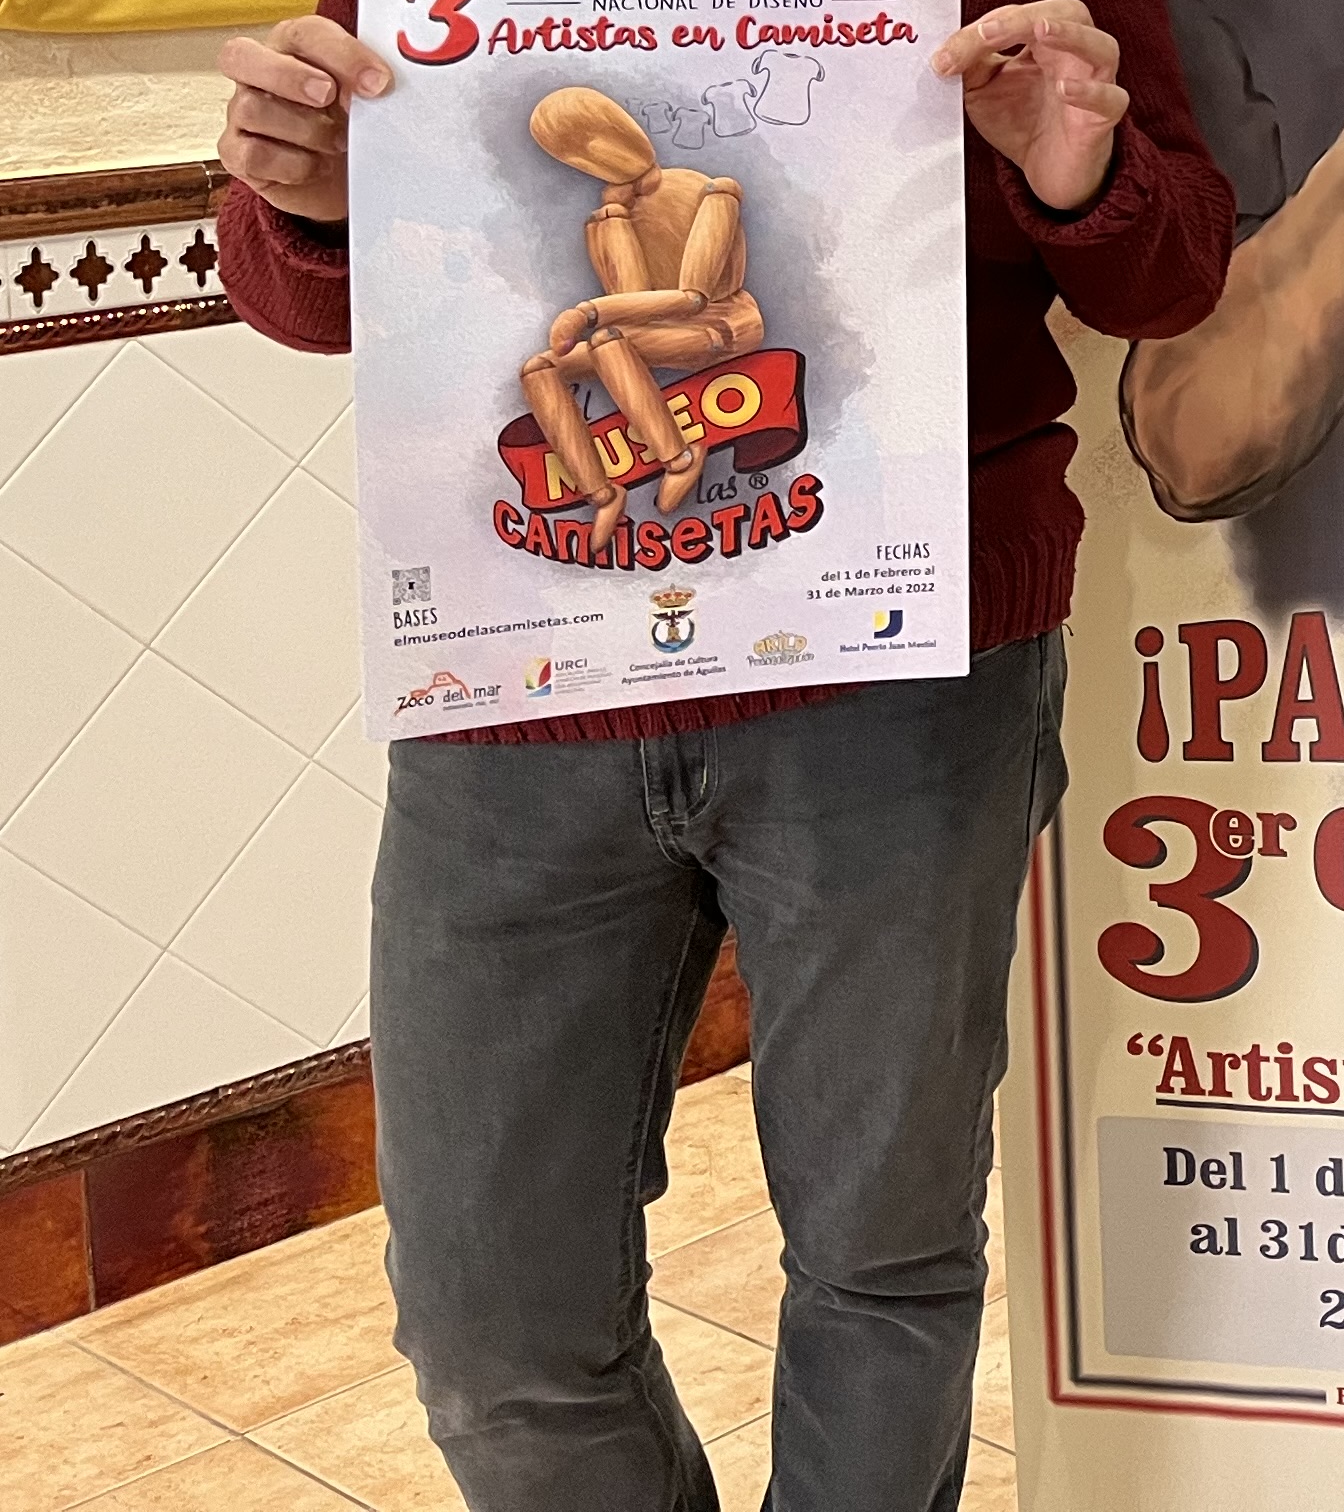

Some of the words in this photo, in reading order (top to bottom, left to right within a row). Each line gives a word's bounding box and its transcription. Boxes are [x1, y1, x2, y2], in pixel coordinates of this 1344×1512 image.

[488, 15, 658, 56] Artistas
[671, 22, 726, 51] en
[735, 13, 918, 50] Camiseta
[876, 543, 930, 561] FECHAS
[821, 571, 840, 582] del
[844, 571, 851, 580] 1
[855, 569, 870, 580] de
[874, 567, 921, 578] Febrero
[925, 565, 935, 576] al
[806, 590, 821, 600] 31
[825, 588, 841, 598] de
[845, 585, 883, 596] Marzo
[887, 584, 902, 595] de
[906, 582, 935, 594] 2022
[393, 607, 438, 629] BASES
[394, 612, 604, 647] elmuseodelascamisetas.com
[555, 658, 588, 671] URCI
[675, 658, 686, 667] de
[621, 670, 681, 685] Ayuntamiento
[684, 668, 694, 677] de
[443, 688, 464, 703] del
[473, 684, 502, 699] mar
[1163, 1146, 1246, 1191] Del
[1269, 1153, 1291, 1194] 1
[1189, 1217, 1242, 1257] al
